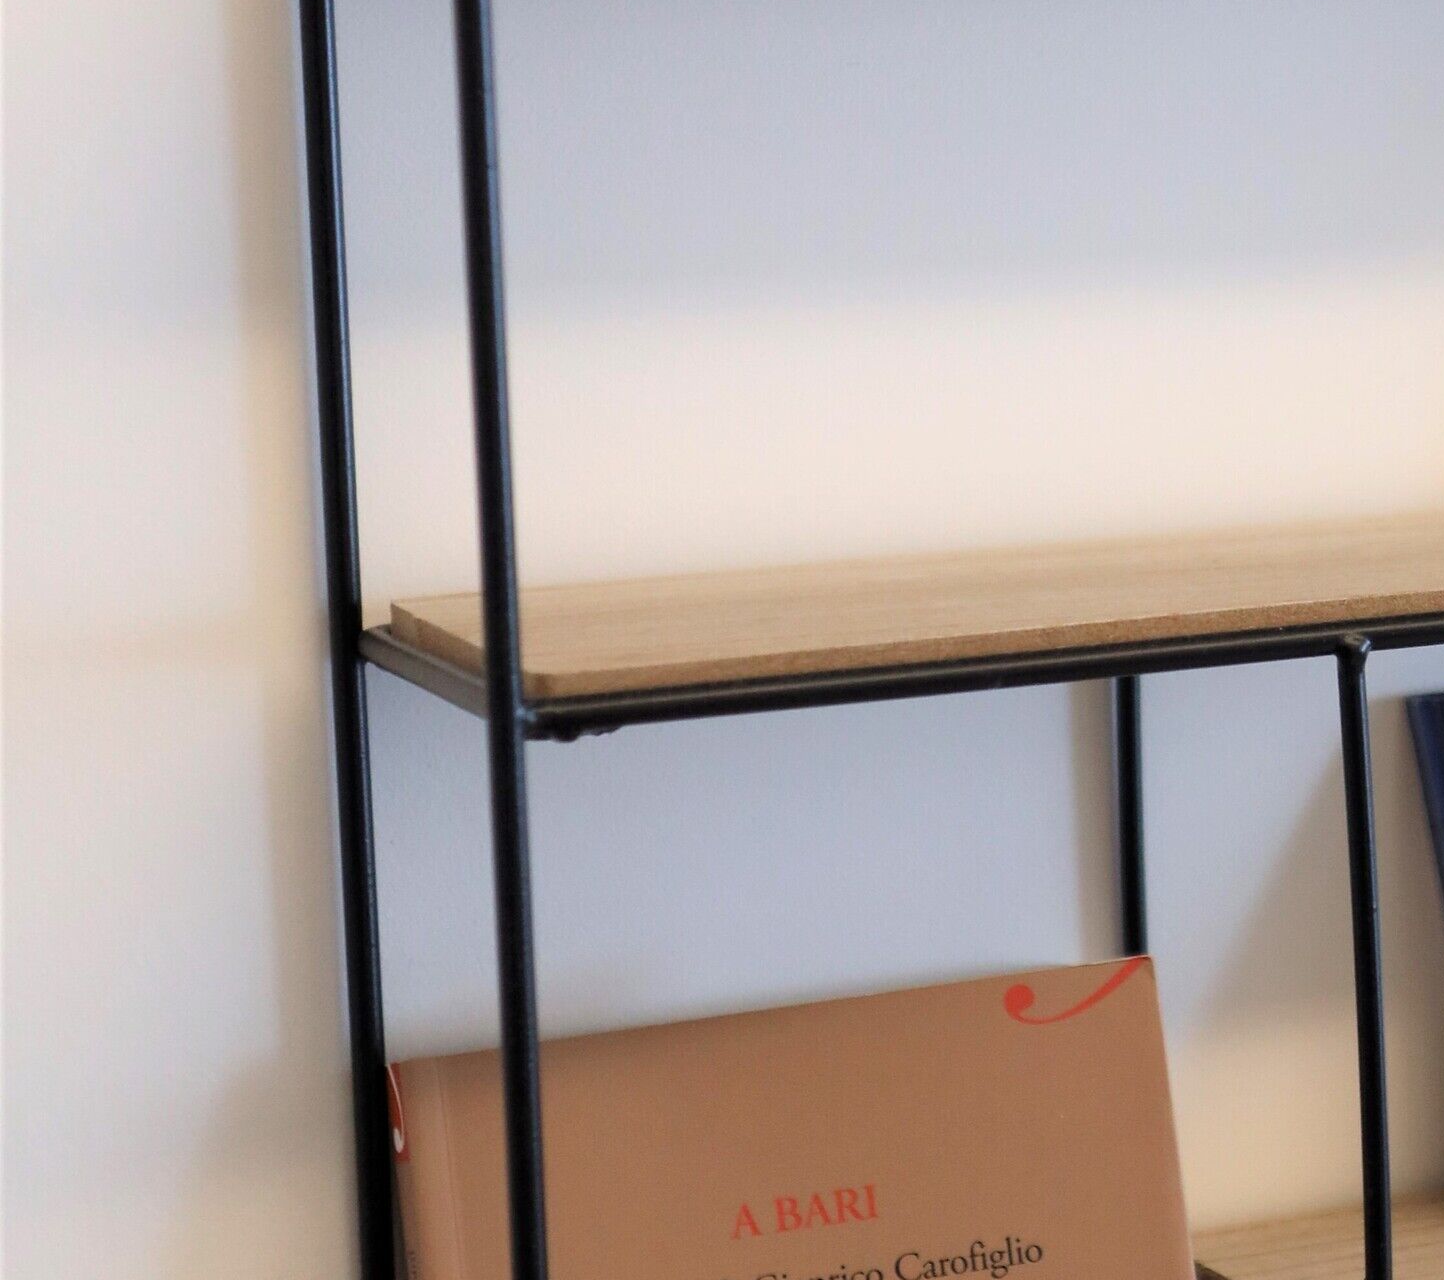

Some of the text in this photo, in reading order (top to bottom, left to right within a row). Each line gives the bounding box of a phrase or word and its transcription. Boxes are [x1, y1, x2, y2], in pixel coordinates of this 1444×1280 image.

[731, 1184, 880, 1239] A BARI
[895, 1236, 1044, 1280] Carofiglio
